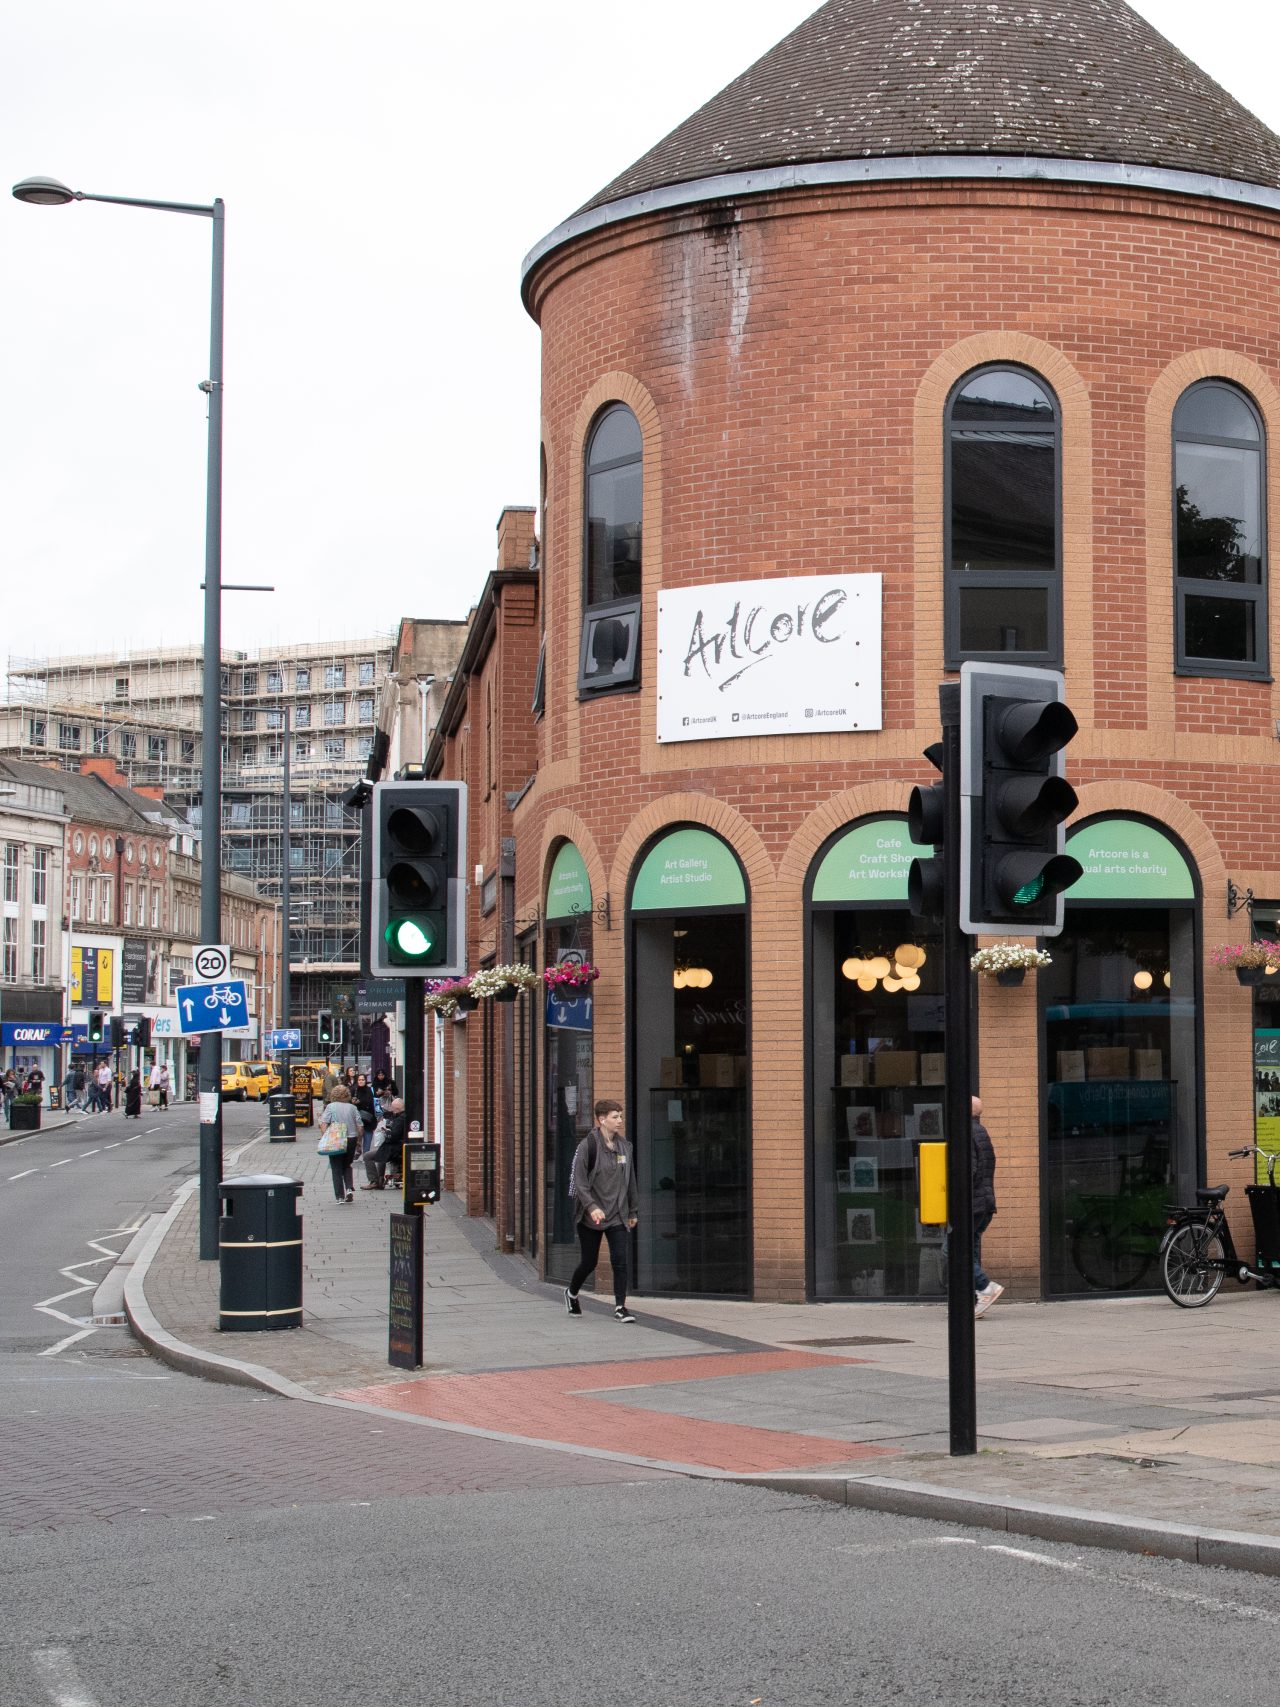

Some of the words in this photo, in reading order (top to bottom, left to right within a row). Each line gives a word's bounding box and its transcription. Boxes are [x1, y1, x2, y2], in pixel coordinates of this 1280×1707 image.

[876, 838, 902, 848] Cafe
[860, 853, 887, 864] Craft
[1088, 848, 1129, 859] Artcore
[1131, 848, 1140, 859] is
[1142, 851, 1150, 859] a
[665, 859, 678, 870] Art
[679, 858, 709, 870] Gallery
[1104, 865, 1126, 874] arts
[1128, 864, 1167, 876] charity
[660, 873, 685, 885] Artist
[685, 871, 713, 884] Studio
[849, 869, 866, 879] Art
[868, 868, 910, 879] Worksh
[200, 957, 221, 970] 20
[14, 1028, 45, 1041] CORAL
